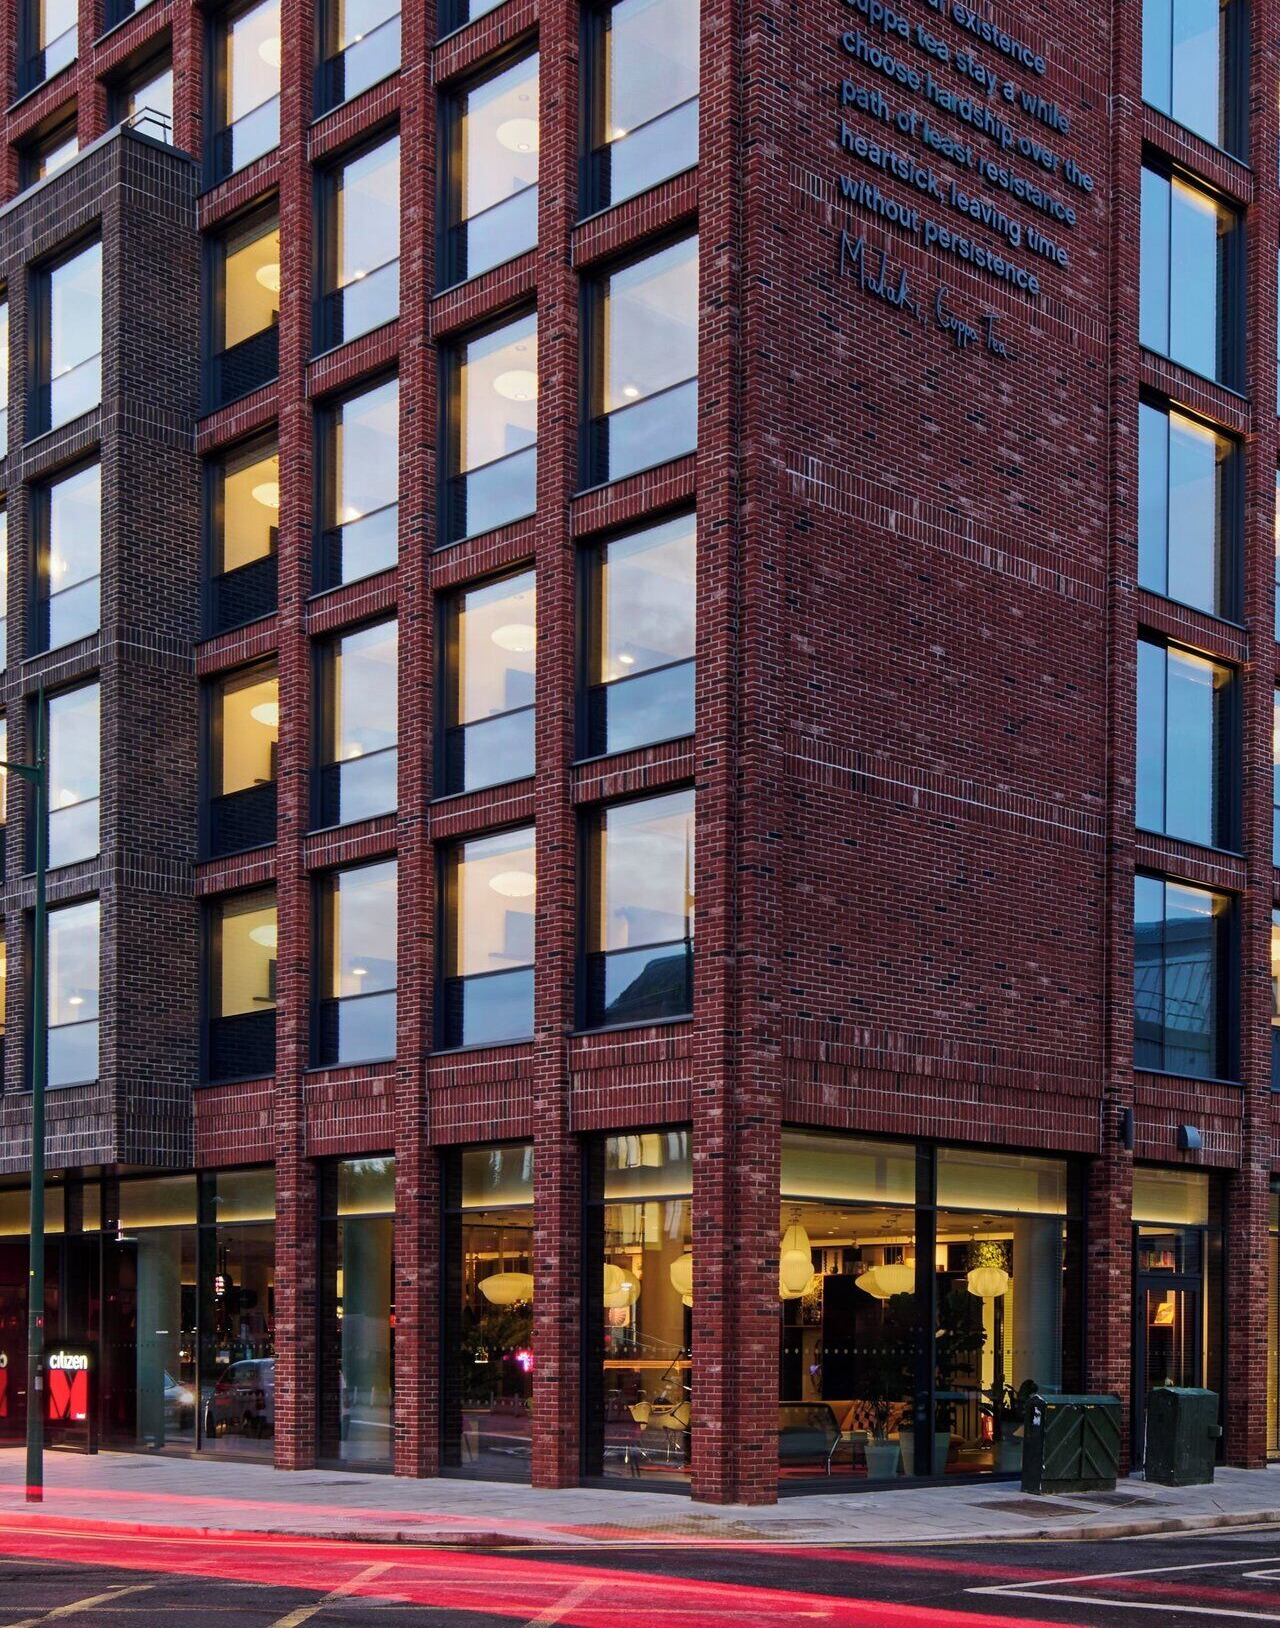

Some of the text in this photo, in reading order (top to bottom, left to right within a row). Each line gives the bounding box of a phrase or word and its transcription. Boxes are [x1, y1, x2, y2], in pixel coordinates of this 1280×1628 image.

[915, 23, 950, 61] tea
[956, 51, 997, 96] stay
[1002, 79, 1016, 102] a
[1020, 91, 1070, 136] while
[953, 3, 1047, 75] existence
[841, 28, 1095, 192] choose hardship over the
[841, 78, 1077, 226] path of least resistance
[840, 121, 1069, 267] heartsick, leaving time
[840, 174, 1041, 296] without persistence
[49, 1350, 89, 1370] citizen
